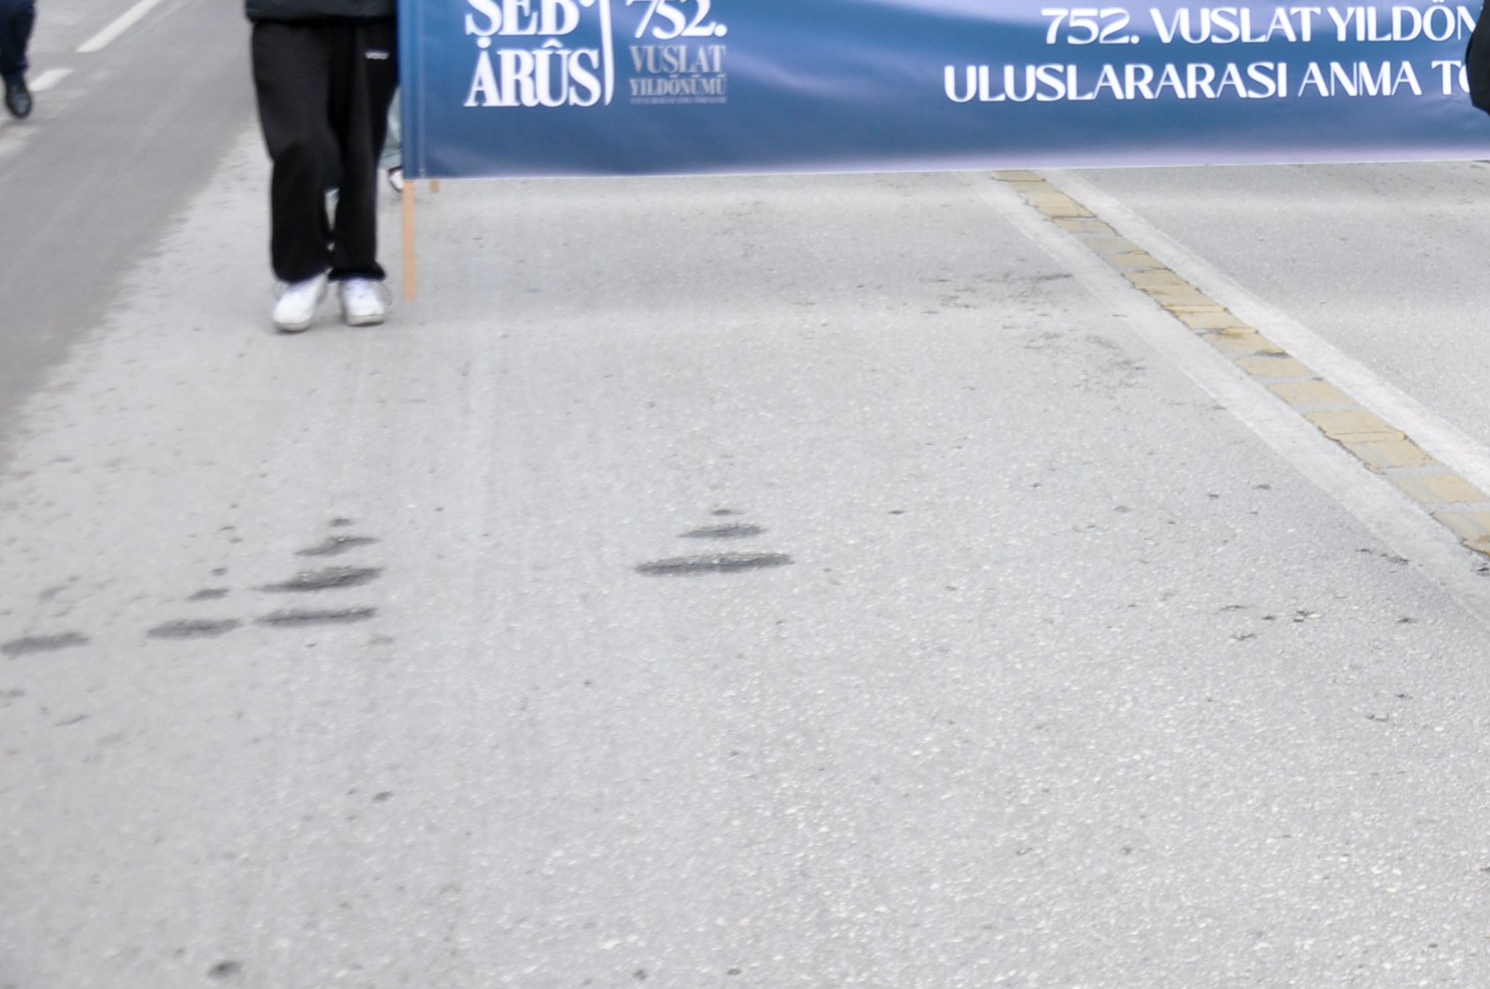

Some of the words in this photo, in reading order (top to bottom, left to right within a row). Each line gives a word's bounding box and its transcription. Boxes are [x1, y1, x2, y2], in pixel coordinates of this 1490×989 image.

[1040, 6, 1140, 44] 752.
[1149, 6, 1322, 44] VUSLAT
[629, 45, 727, 74] VUSLAT
[629, 74, 727, 96] YILDÖNÜMÜ
[943, 61, 1288, 103] ULUSLARARASI
[1298, 60, 1423, 98] ANMA
